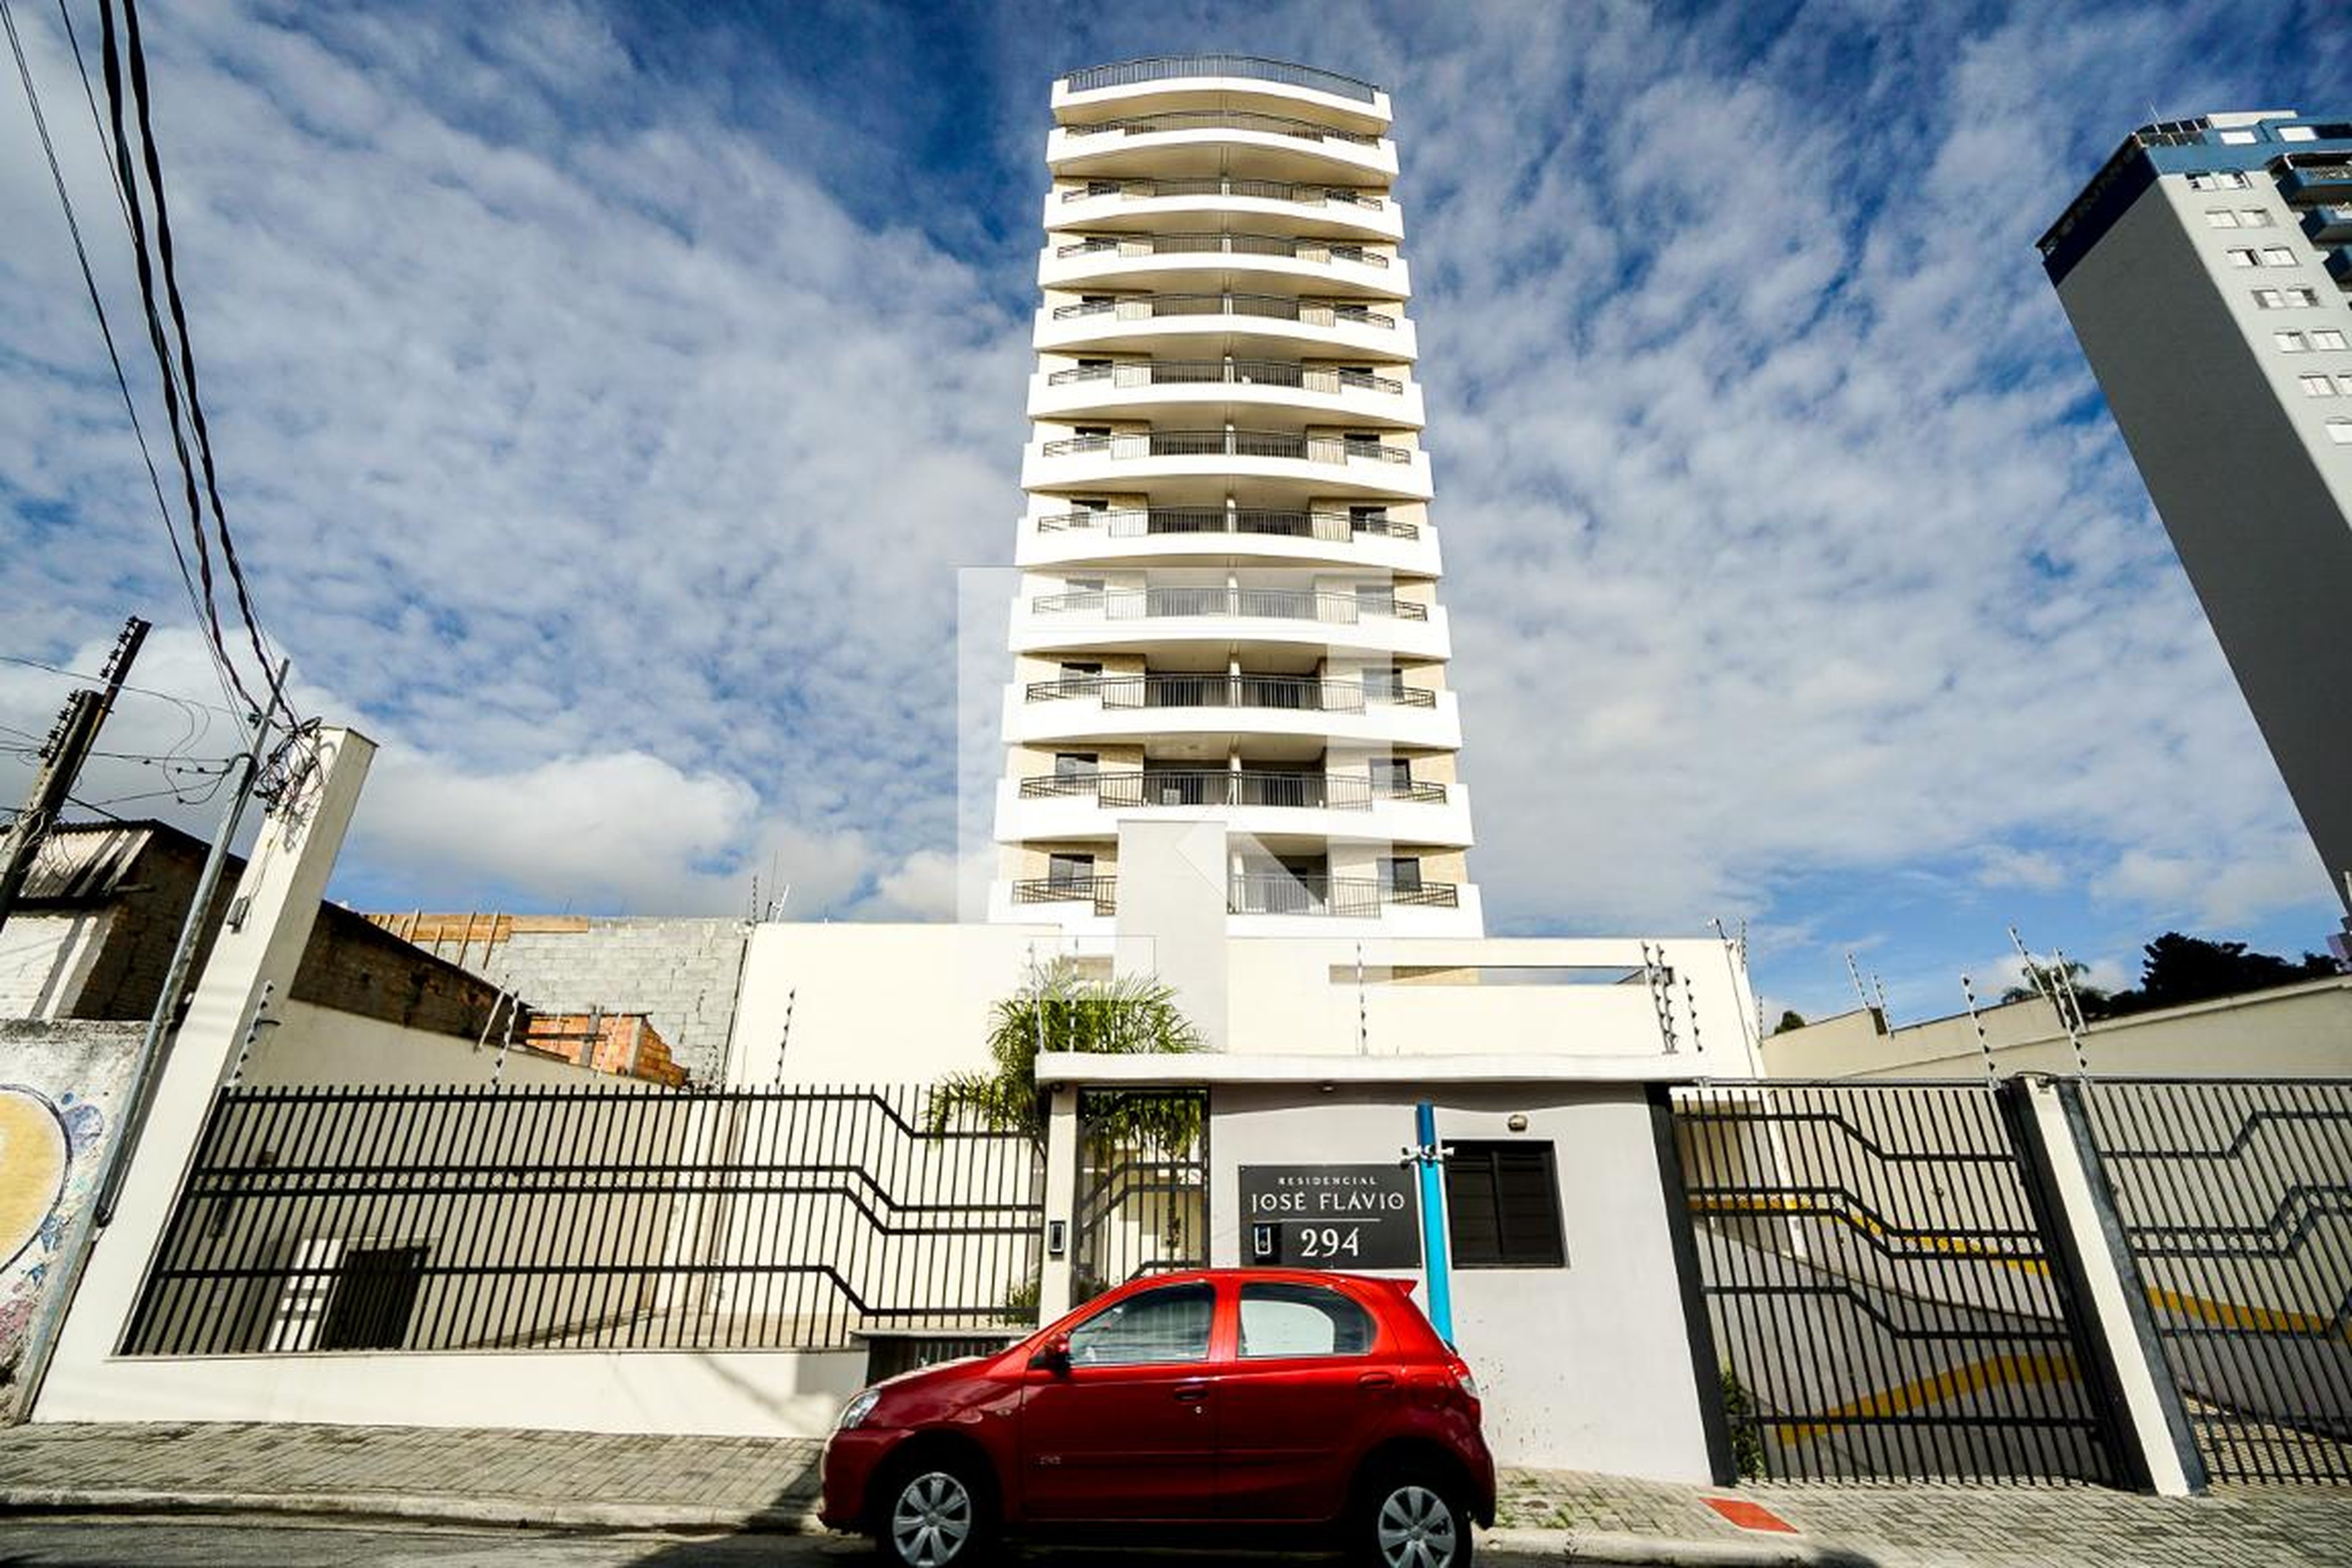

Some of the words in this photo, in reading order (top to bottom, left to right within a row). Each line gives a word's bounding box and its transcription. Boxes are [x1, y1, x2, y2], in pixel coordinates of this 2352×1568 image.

[1278, 1175, 1377, 1186] RESIDENCIAL
[1252, 1191, 1307, 1213] JOSÉ
[1319, 1191, 1406, 1211] FLÁVIO
[1300, 1227, 1360, 1257] 294
